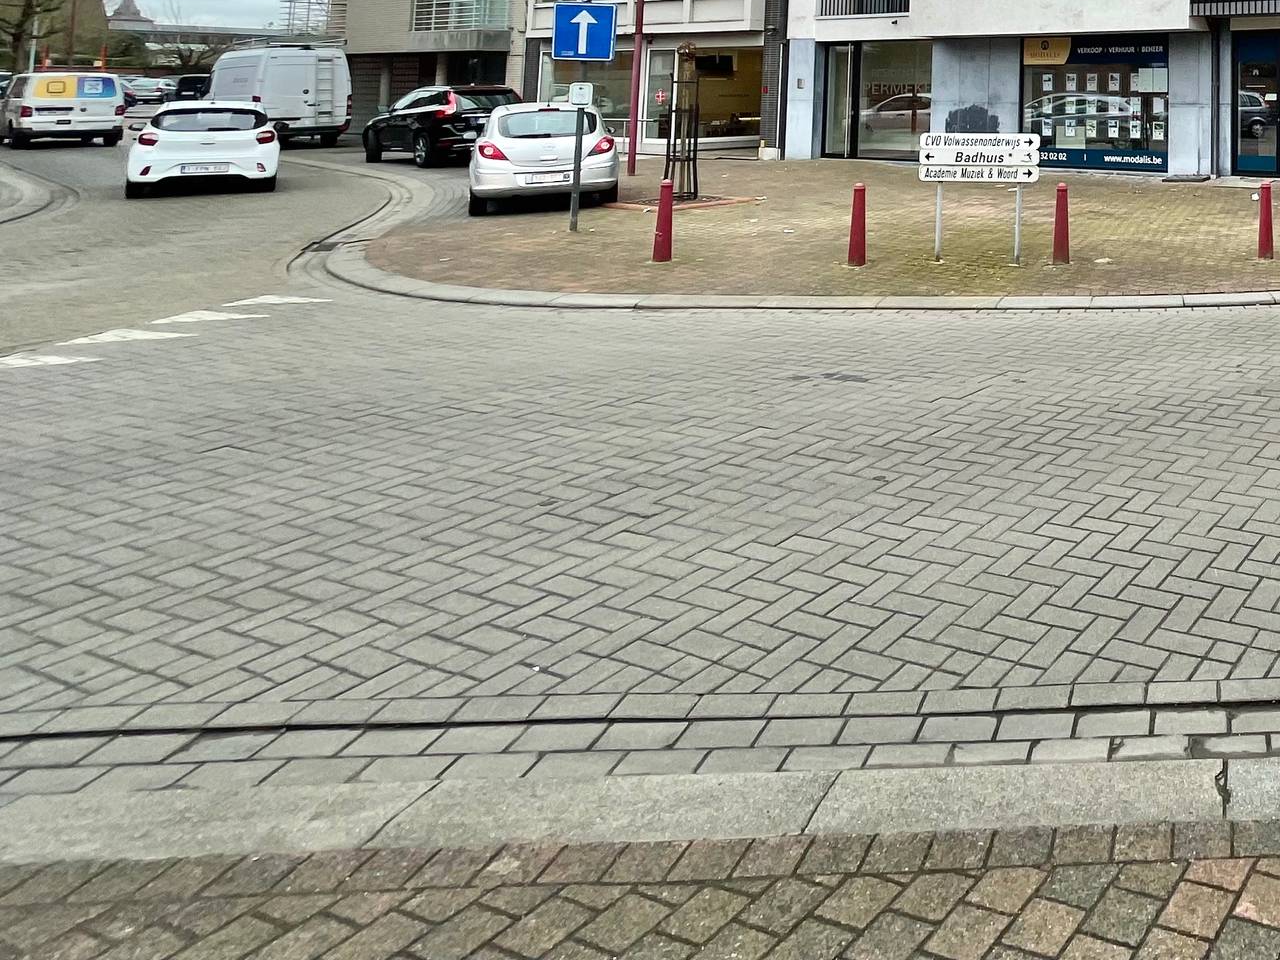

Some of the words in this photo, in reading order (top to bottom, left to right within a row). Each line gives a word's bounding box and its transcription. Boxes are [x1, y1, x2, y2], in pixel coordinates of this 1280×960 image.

[1108, 46, 1135, 54] VERHUUR
[1141, 45, 1163, 53] BEHEER
[925, 135, 942, 146] CVO
[943, 135, 1021, 150] Volwassenonderwijs
[955, 151, 1005, 163] Badhuis
[1040, 152, 1048, 160] 32
[1049, 152, 1057, 160] 02
[1058, 152, 1067, 161] 02
[1103, 155, 1163, 165] www.modalis.be
[924, 168, 957, 179] Academie
[960, 168, 984, 179] Muziek
[987, 168, 994, 178] &
[997, 168, 1019, 179] Woord
